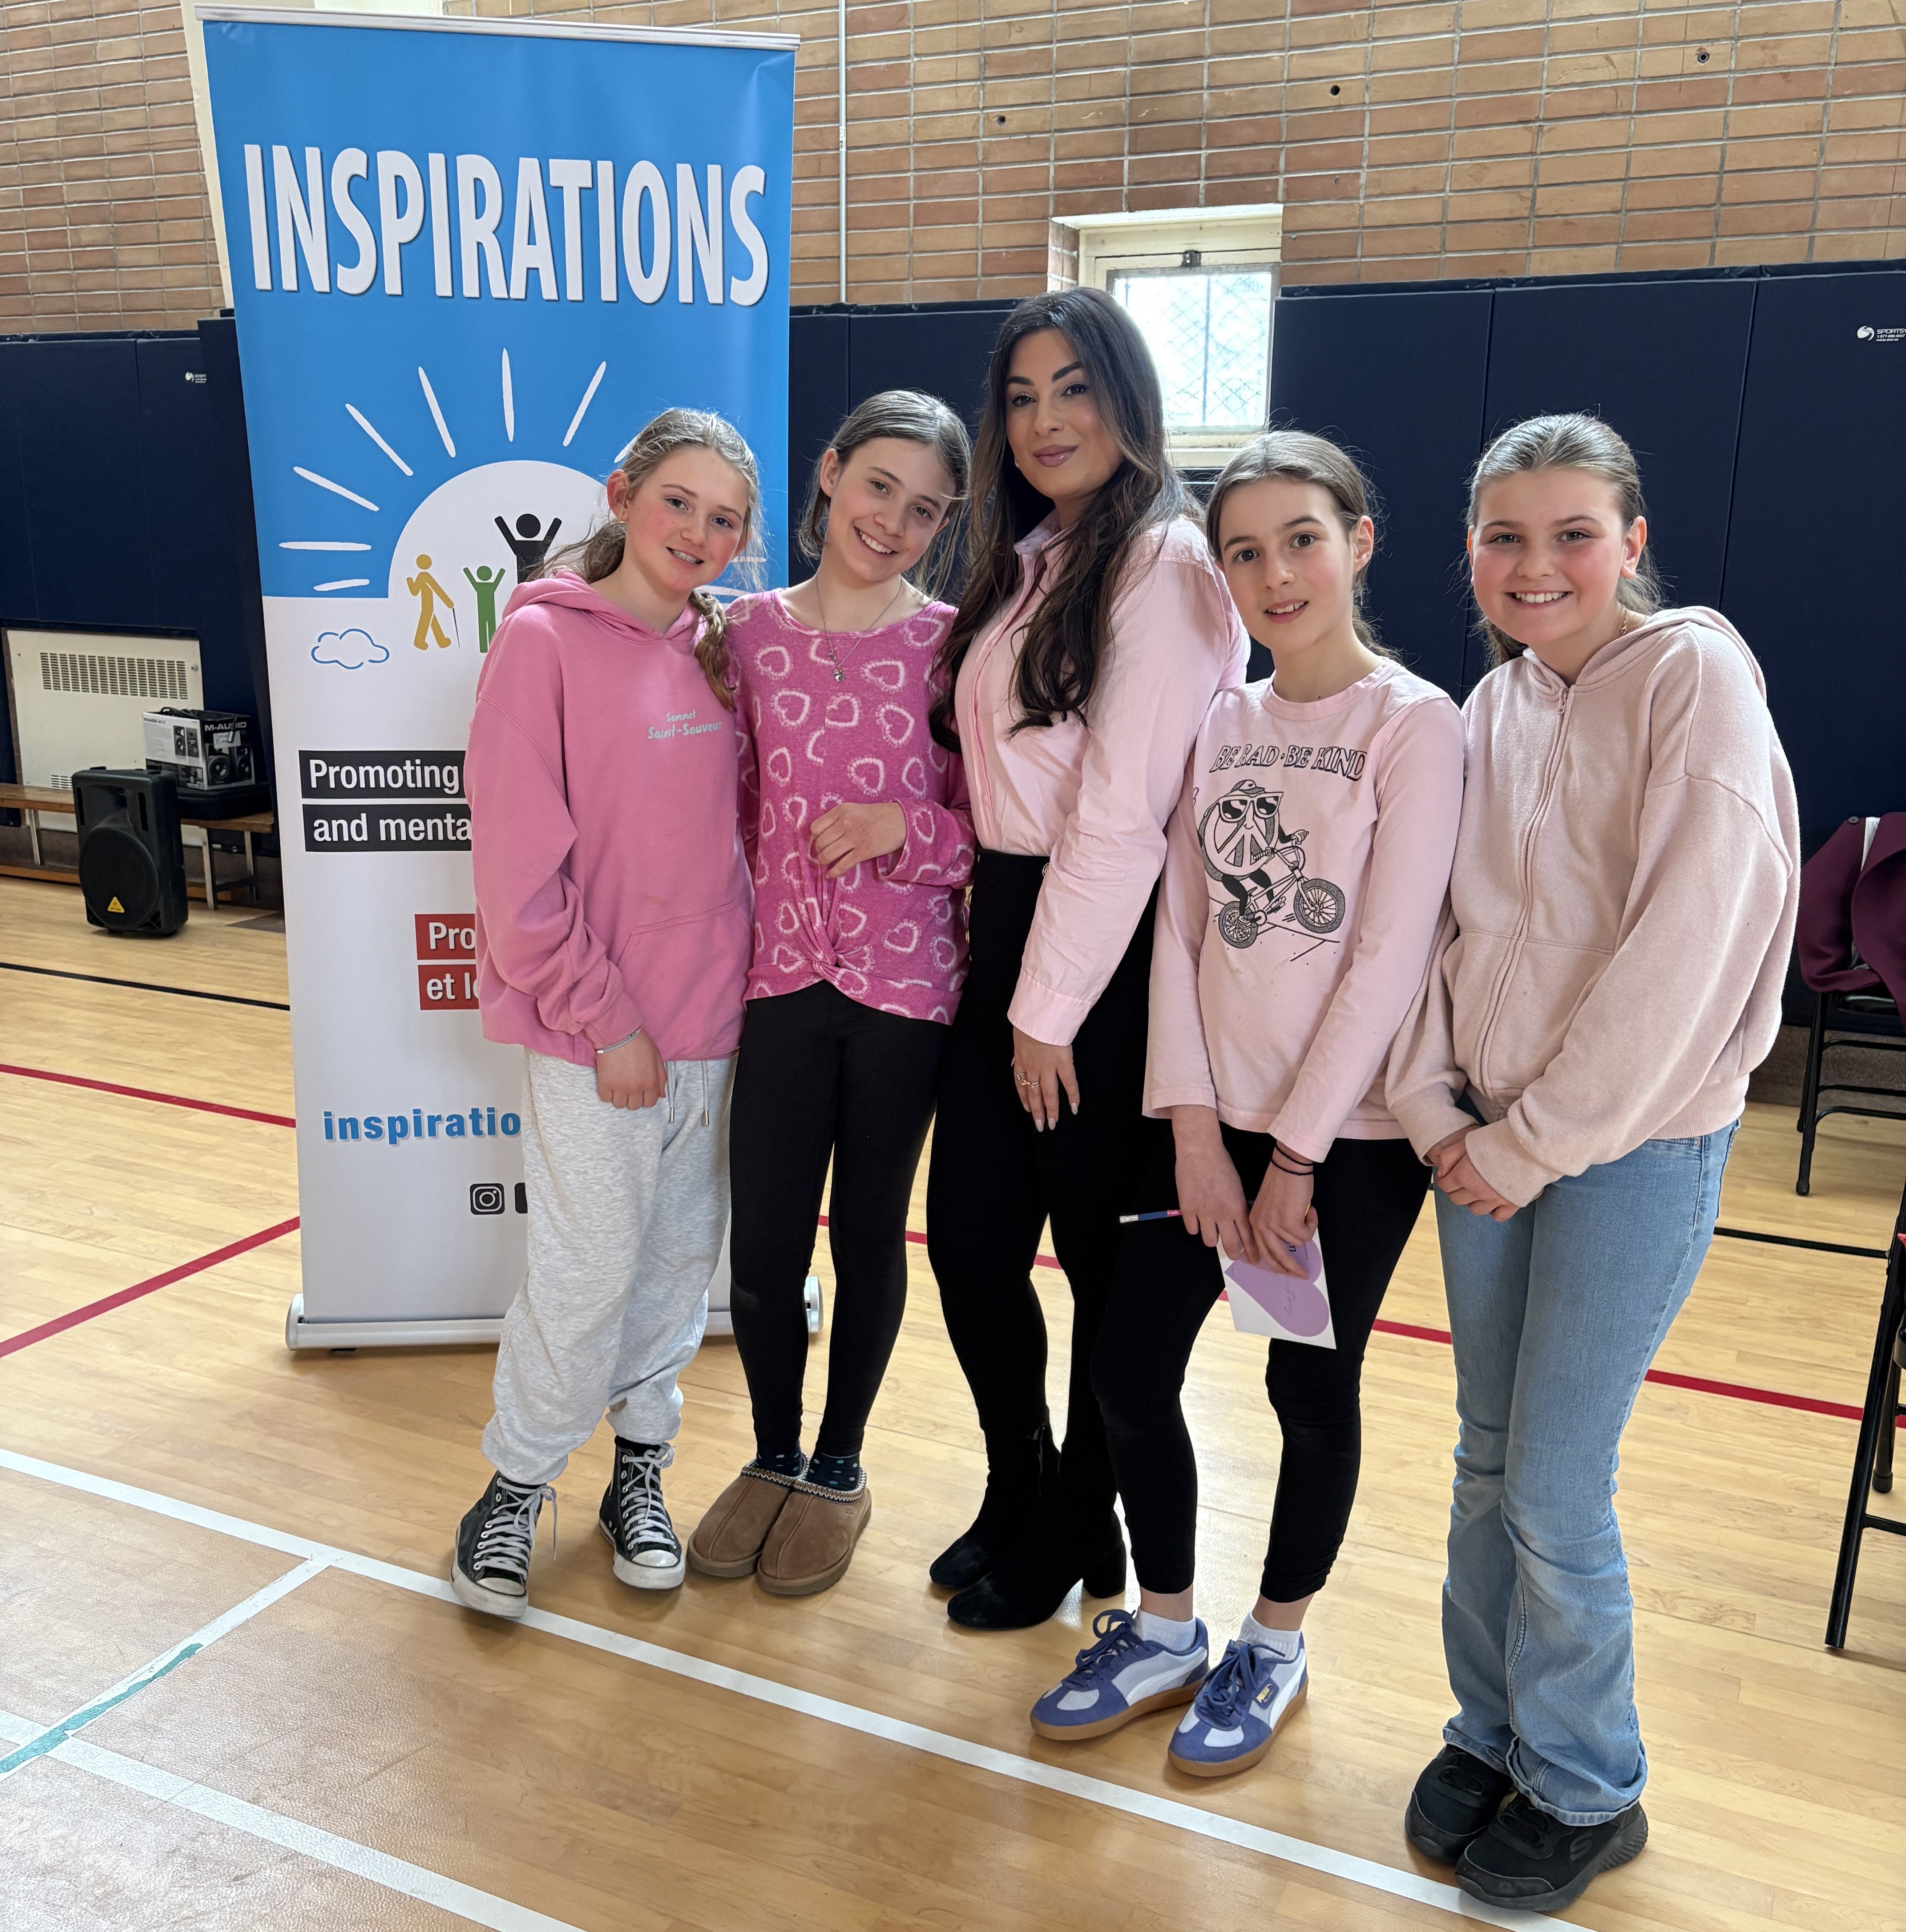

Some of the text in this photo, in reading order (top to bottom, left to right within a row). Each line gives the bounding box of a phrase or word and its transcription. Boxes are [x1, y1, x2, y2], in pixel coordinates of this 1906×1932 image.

[244, 143, 769, 307] INSPIRATIONS
[666, 709, 696, 722] Sommet
[647, 721, 722, 740] Saint-Sauveur
[309, 758, 460, 795] Promoting
[1209, 745, 1241, 773] BE
[1283, 745, 1313, 768] BE
[1311, 746, 1368, 782] KIND
[313, 813, 472, 842] and menta
[429, 922, 476, 950] Pro
[426, 973, 456, 1000] et
[323, 1106, 521, 1146] inspiratio
